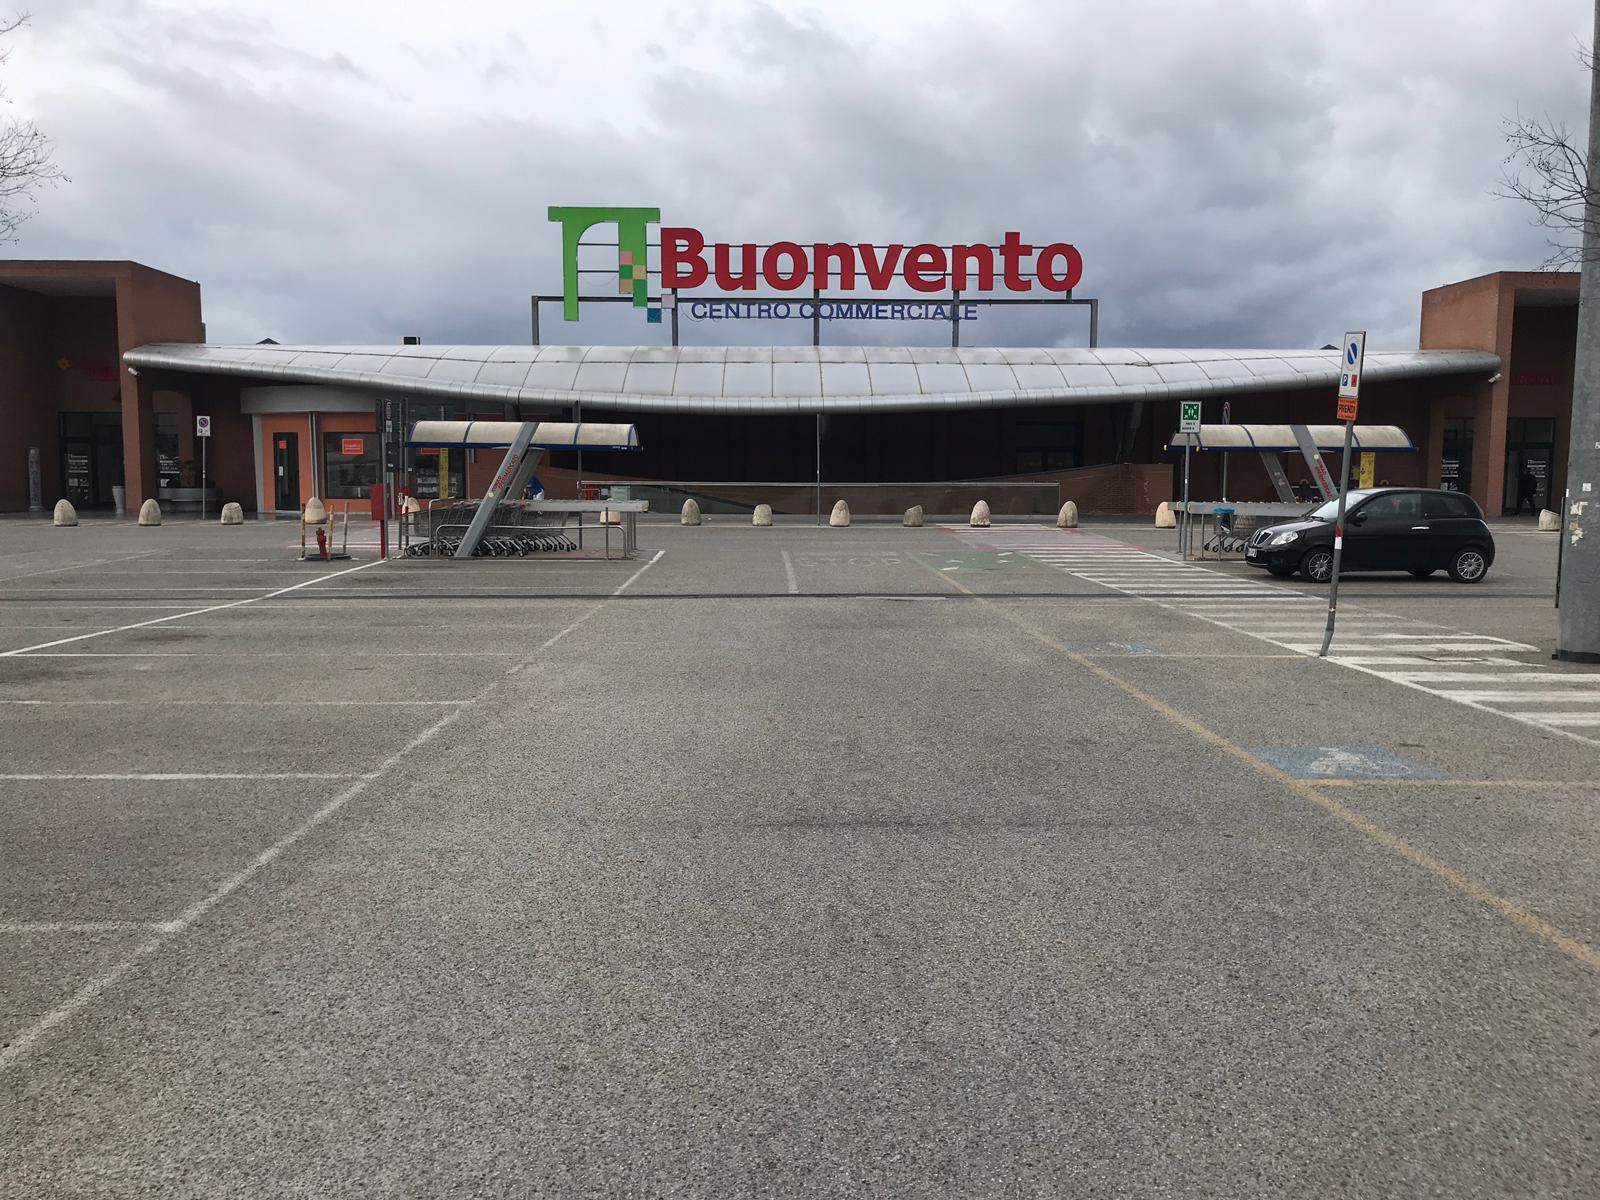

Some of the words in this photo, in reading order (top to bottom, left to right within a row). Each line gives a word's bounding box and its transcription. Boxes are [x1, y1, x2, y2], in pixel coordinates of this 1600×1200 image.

[661, 227, 1082, 291] Buonvento
[691, 302, 790, 319] CENTRO
[799, 302, 977, 320] COMMERCIALE
